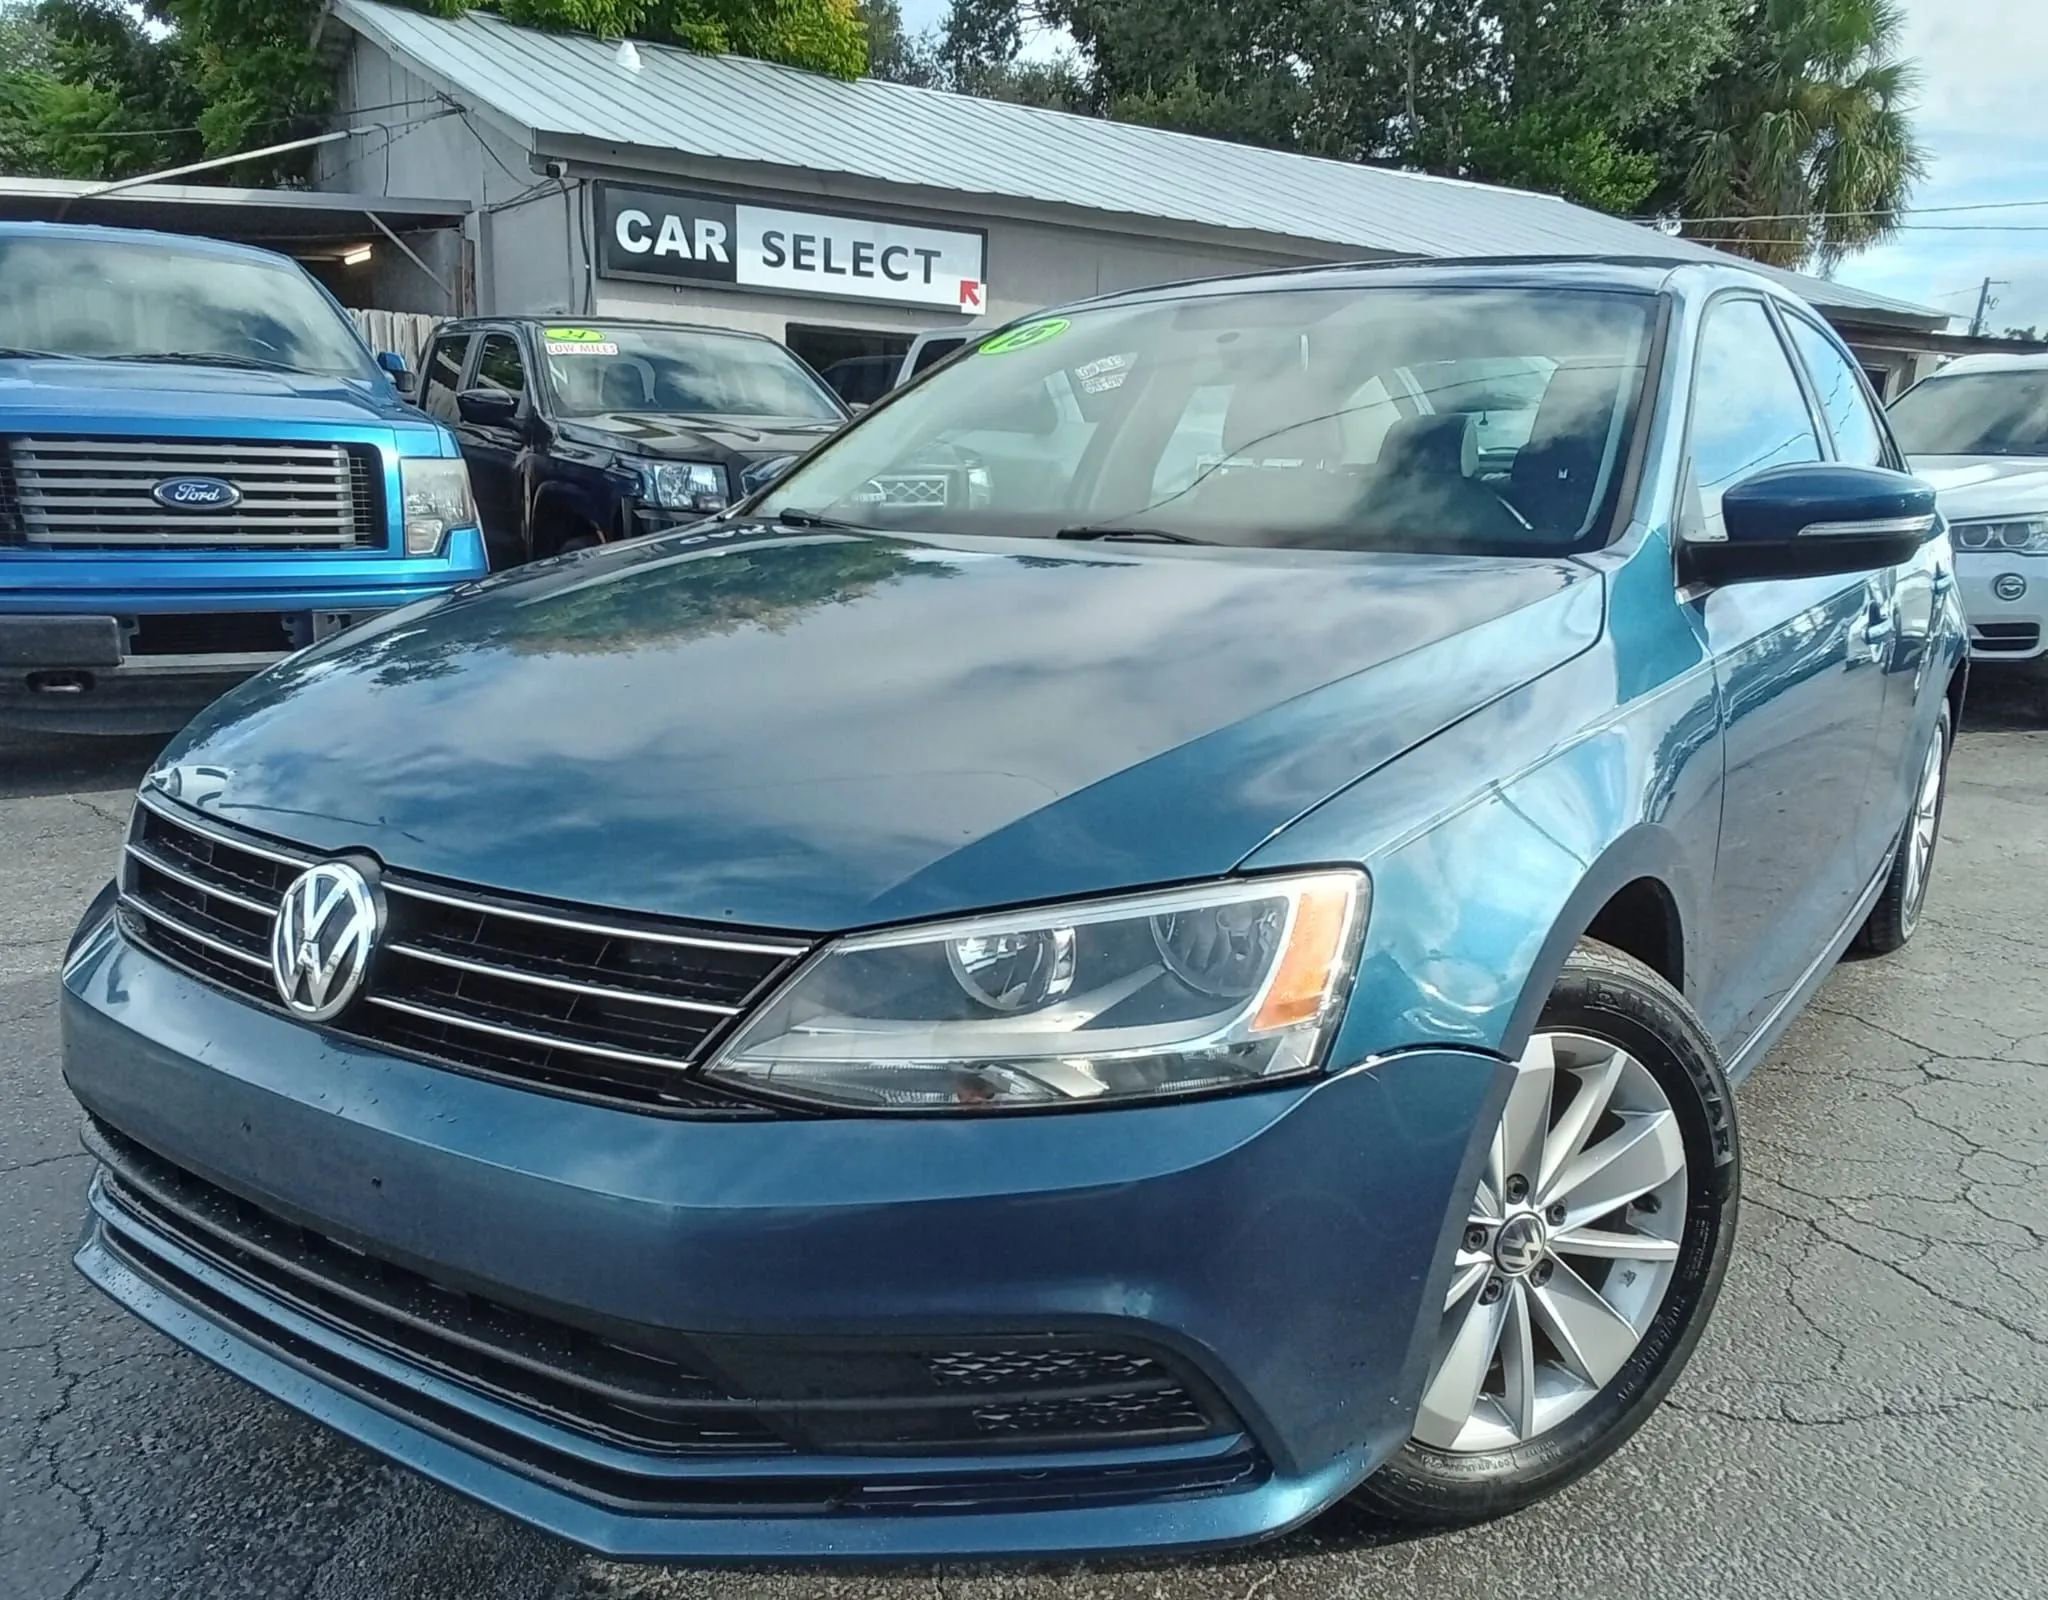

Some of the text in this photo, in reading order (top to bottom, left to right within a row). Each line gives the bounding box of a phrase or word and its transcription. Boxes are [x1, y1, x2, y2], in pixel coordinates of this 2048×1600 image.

[615, 209, 942, 285] CAR SELECT
[548, 343, 617, 354] LOW MILES
[174, 483, 220, 501] Ford
